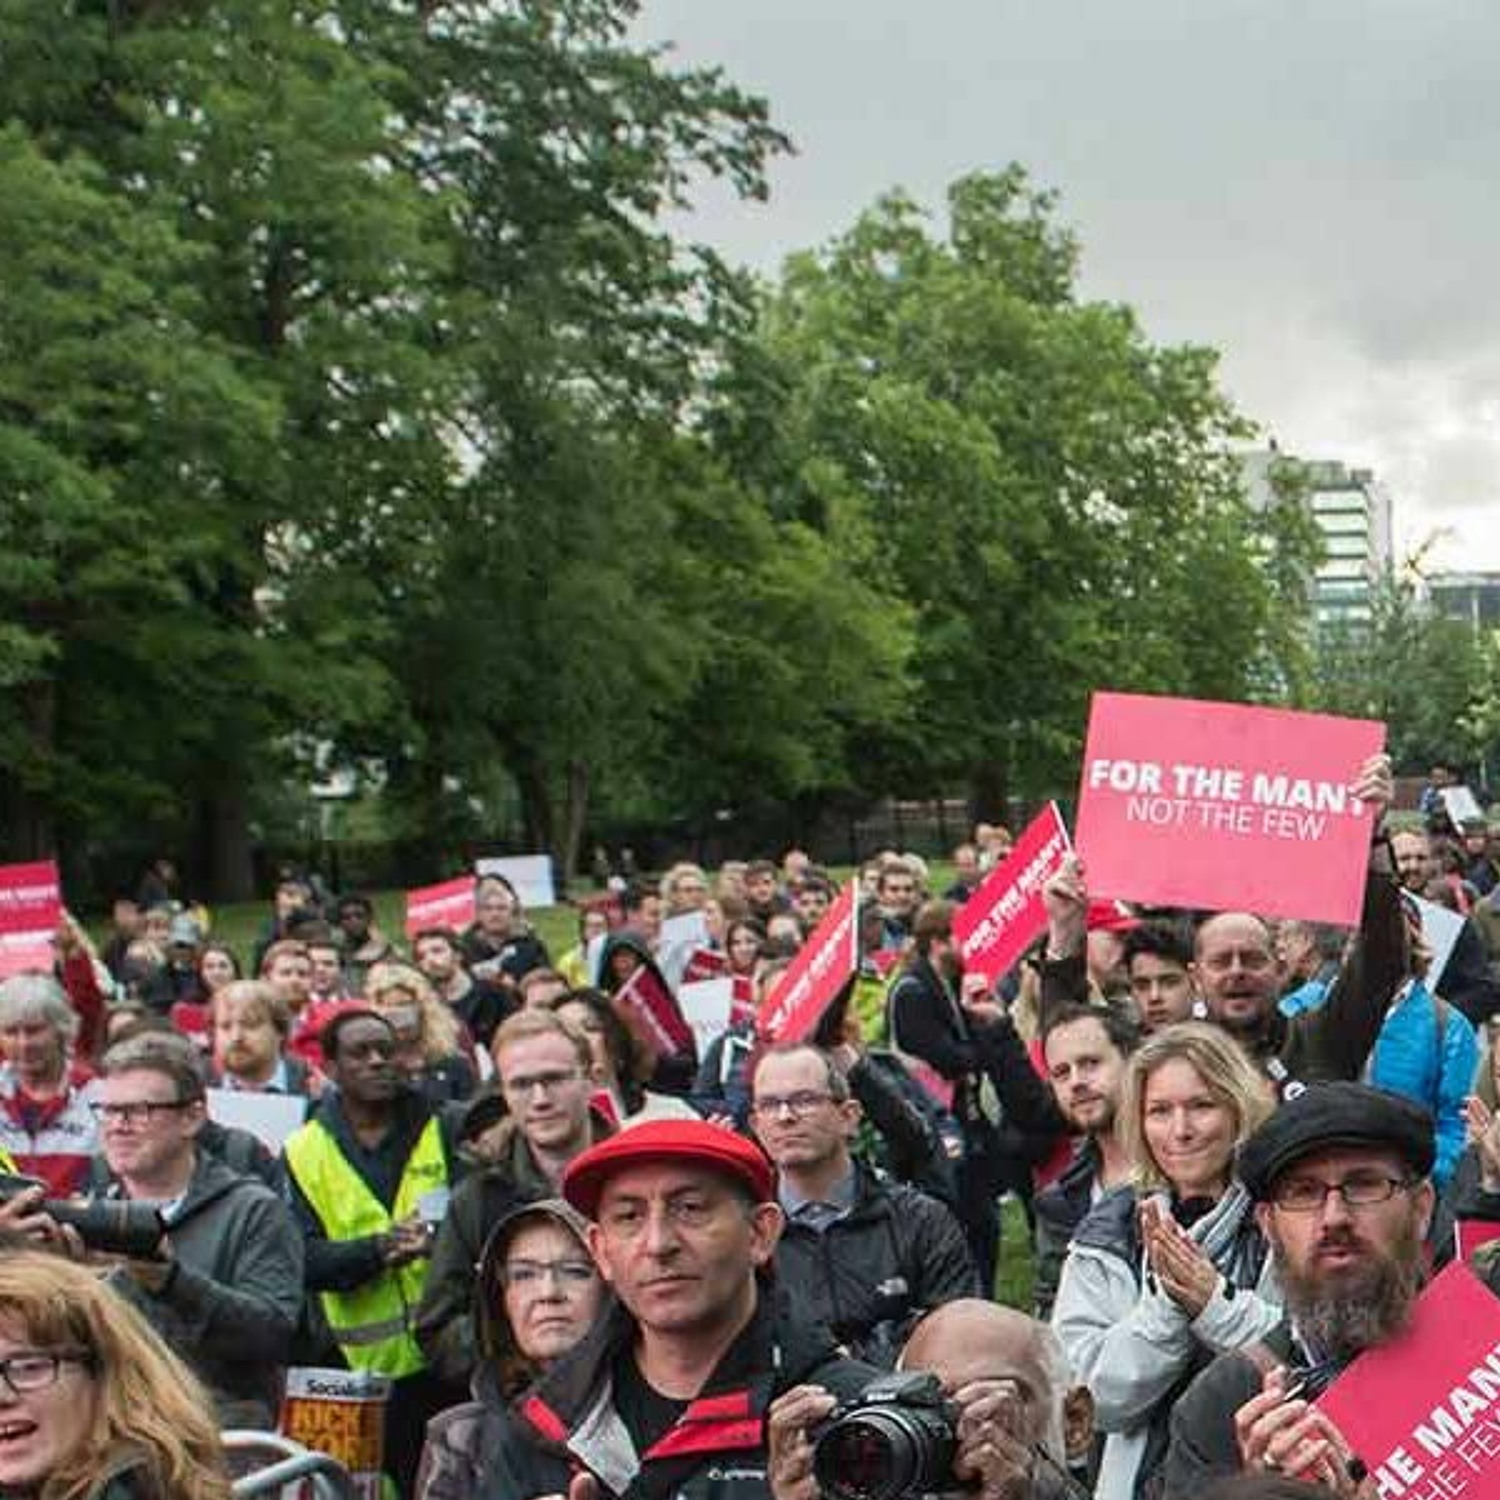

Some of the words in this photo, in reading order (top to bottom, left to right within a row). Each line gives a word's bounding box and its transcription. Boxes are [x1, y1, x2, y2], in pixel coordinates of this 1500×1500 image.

[1090, 759, 1162, 794] FOR
[1171, 766, 1243, 802] THE
[1126, 797, 1191, 824] NOT
[1198, 801, 1254, 833] THE
[1262, 809, 1325, 841] FEW
